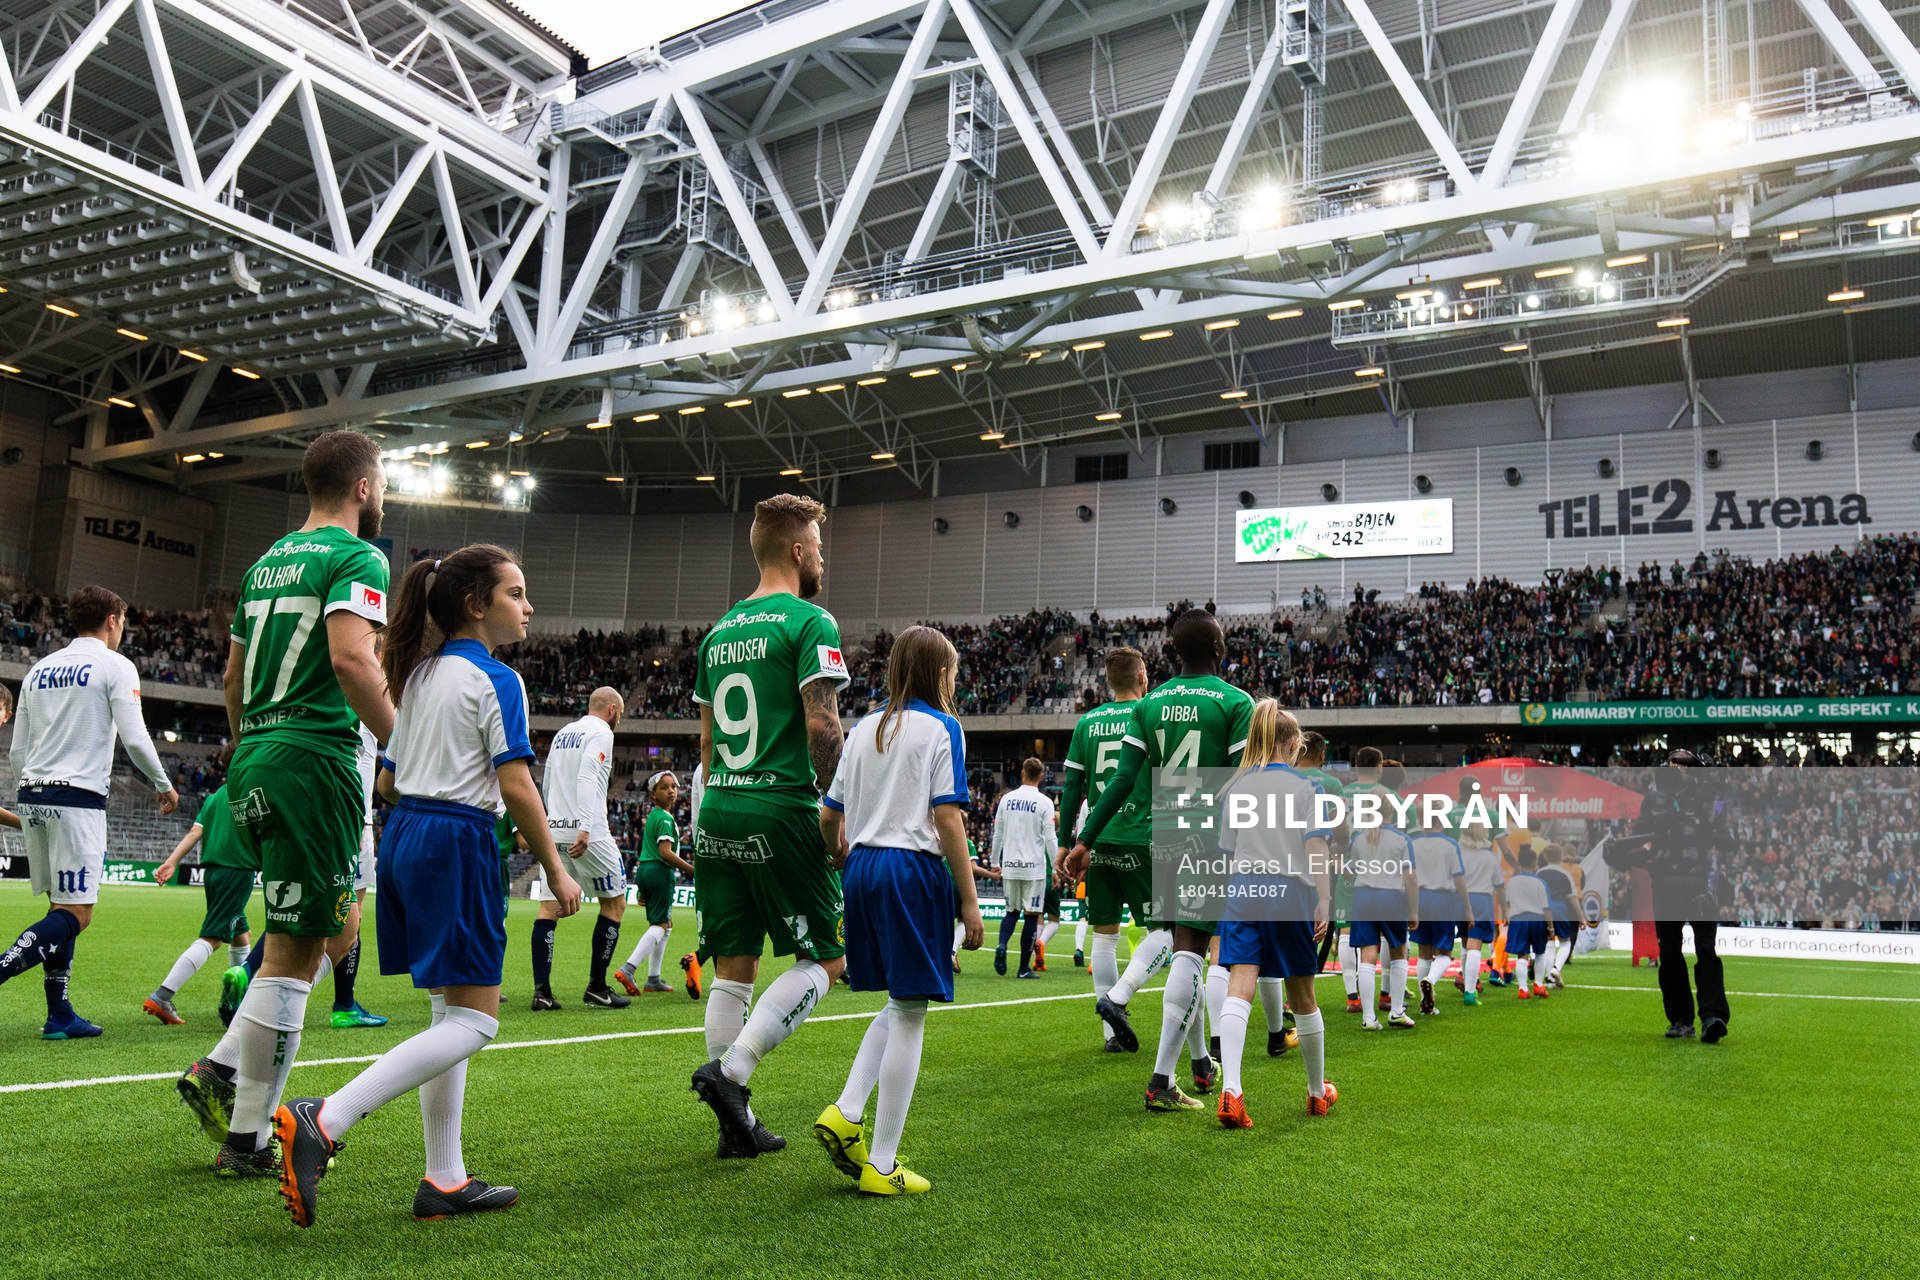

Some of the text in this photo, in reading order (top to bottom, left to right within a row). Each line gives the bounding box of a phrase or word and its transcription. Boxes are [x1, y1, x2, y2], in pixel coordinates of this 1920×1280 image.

[1539, 479, 1872, 539] TELE2 Arena
[1354, 511, 1396, 530] BAJEN
[84, 516, 196, 558] TELE2 Arena
[1331, 530, 1364, 547] 242
[251, 562, 306, 591] SOLHEIM
[740, 611, 788, 628] pantbank
[243, 596, 321, 705] 77
[707, 637, 768, 669] SVENDSEN
[29, 663, 92, 691] PEKING
[1180, 686, 1225, 700] pantbank
[1110, 707, 1133, 716] pantb
[1161, 705, 1199, 722] DIBBA
[1551, 702, 1920, 720] HAMMARBY FOTBOLL GEMENSKAP RESPEKT K
[713, 672, 759, 770] 9
[1088, 721, 1130, 738] FÄLLMA
[552, 732, 586, 750] PEKING
[1095, 740, 1122, 794] 5
[722, 773, 755, 787] LINE
[1006, 799, 1037, 813] PEKING
[1004, 859, 1036, 869] stadium
[57, 865, 90, 894] nt
[592, 872, 614, 892] nt
[1734, 936, 1755, 948] för
[1760, 935, 1914, 956] Barncancerfonden
[781, 987, 816, 1028] ARNEN
